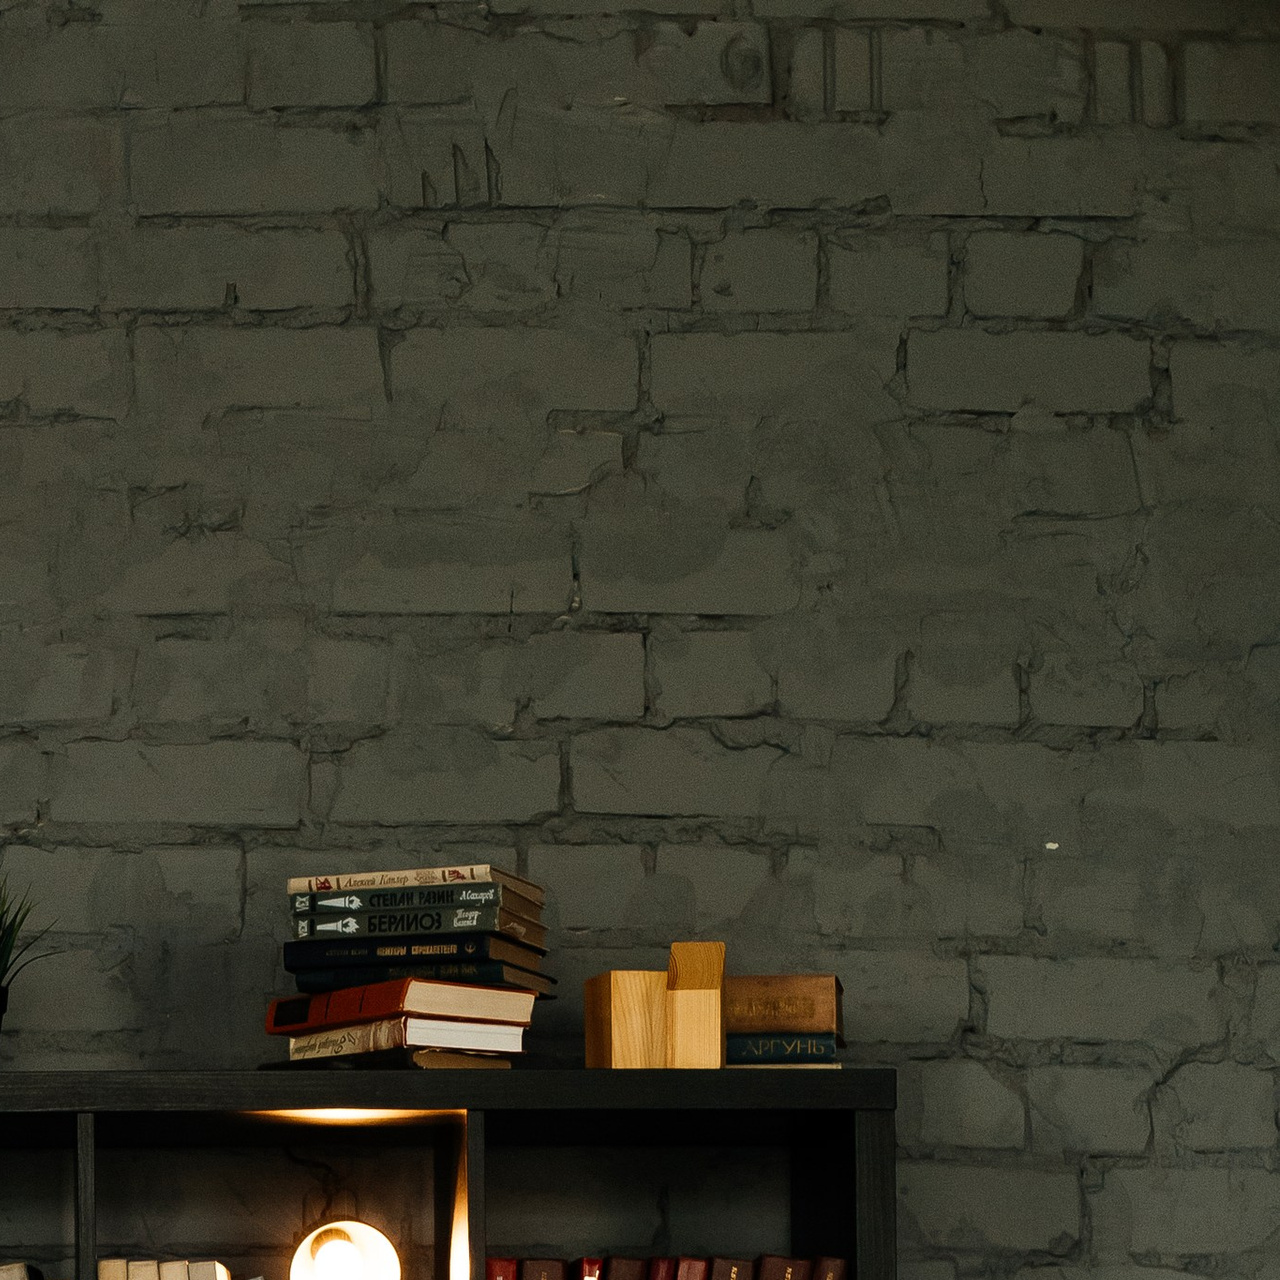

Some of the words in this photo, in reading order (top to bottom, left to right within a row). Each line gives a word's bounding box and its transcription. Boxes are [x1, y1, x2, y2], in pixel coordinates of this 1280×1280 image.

[369, 892, 413, 908] СТЕПАН
[418, 889, 455, 905] РАЗИН
[367, 912, 443, 934] БЕРЛИОЗ
[741, 1038, 826, 1057] АРГУНЬ
